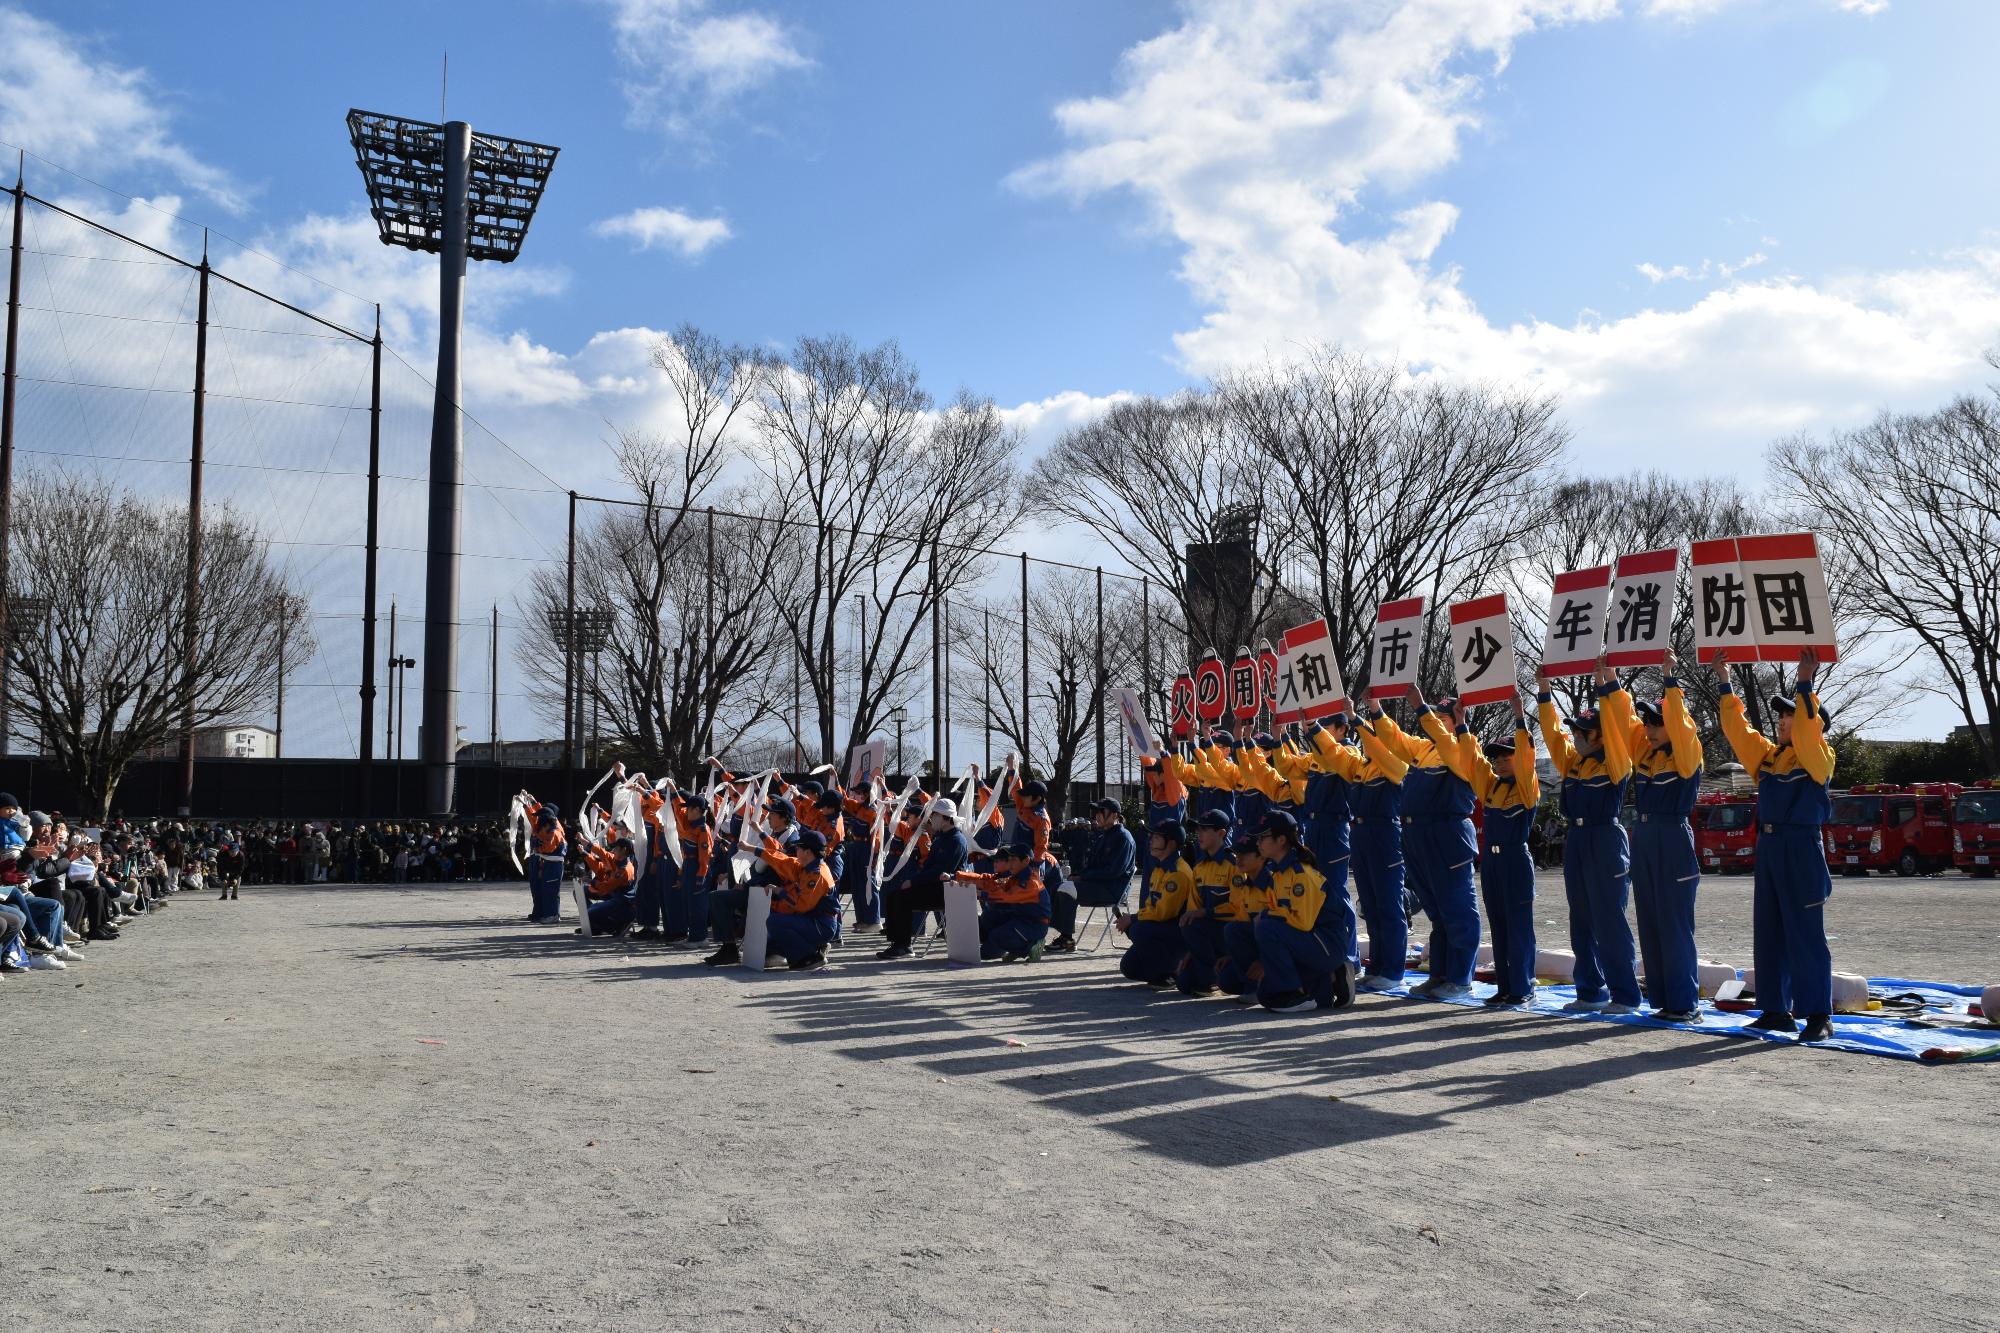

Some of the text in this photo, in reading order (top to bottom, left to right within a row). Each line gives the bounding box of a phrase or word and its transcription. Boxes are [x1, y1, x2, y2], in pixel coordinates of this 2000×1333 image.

[1553, 599, 1593, 652] 年
[1616, 582, 1661, 643] 消
[1702, 573, 1746, 637] 防
[1753, 570, 1814, 635] 団
[1297, 652, 1333, 700] 和
[1380, 627, 1413, 677] 市
[1461, 626, 1502, 683] 少
[1171, 684, 1193, 724] 火
[1199, 671, 1220, 705] の
[1231, 665, 1254, 710] 用
